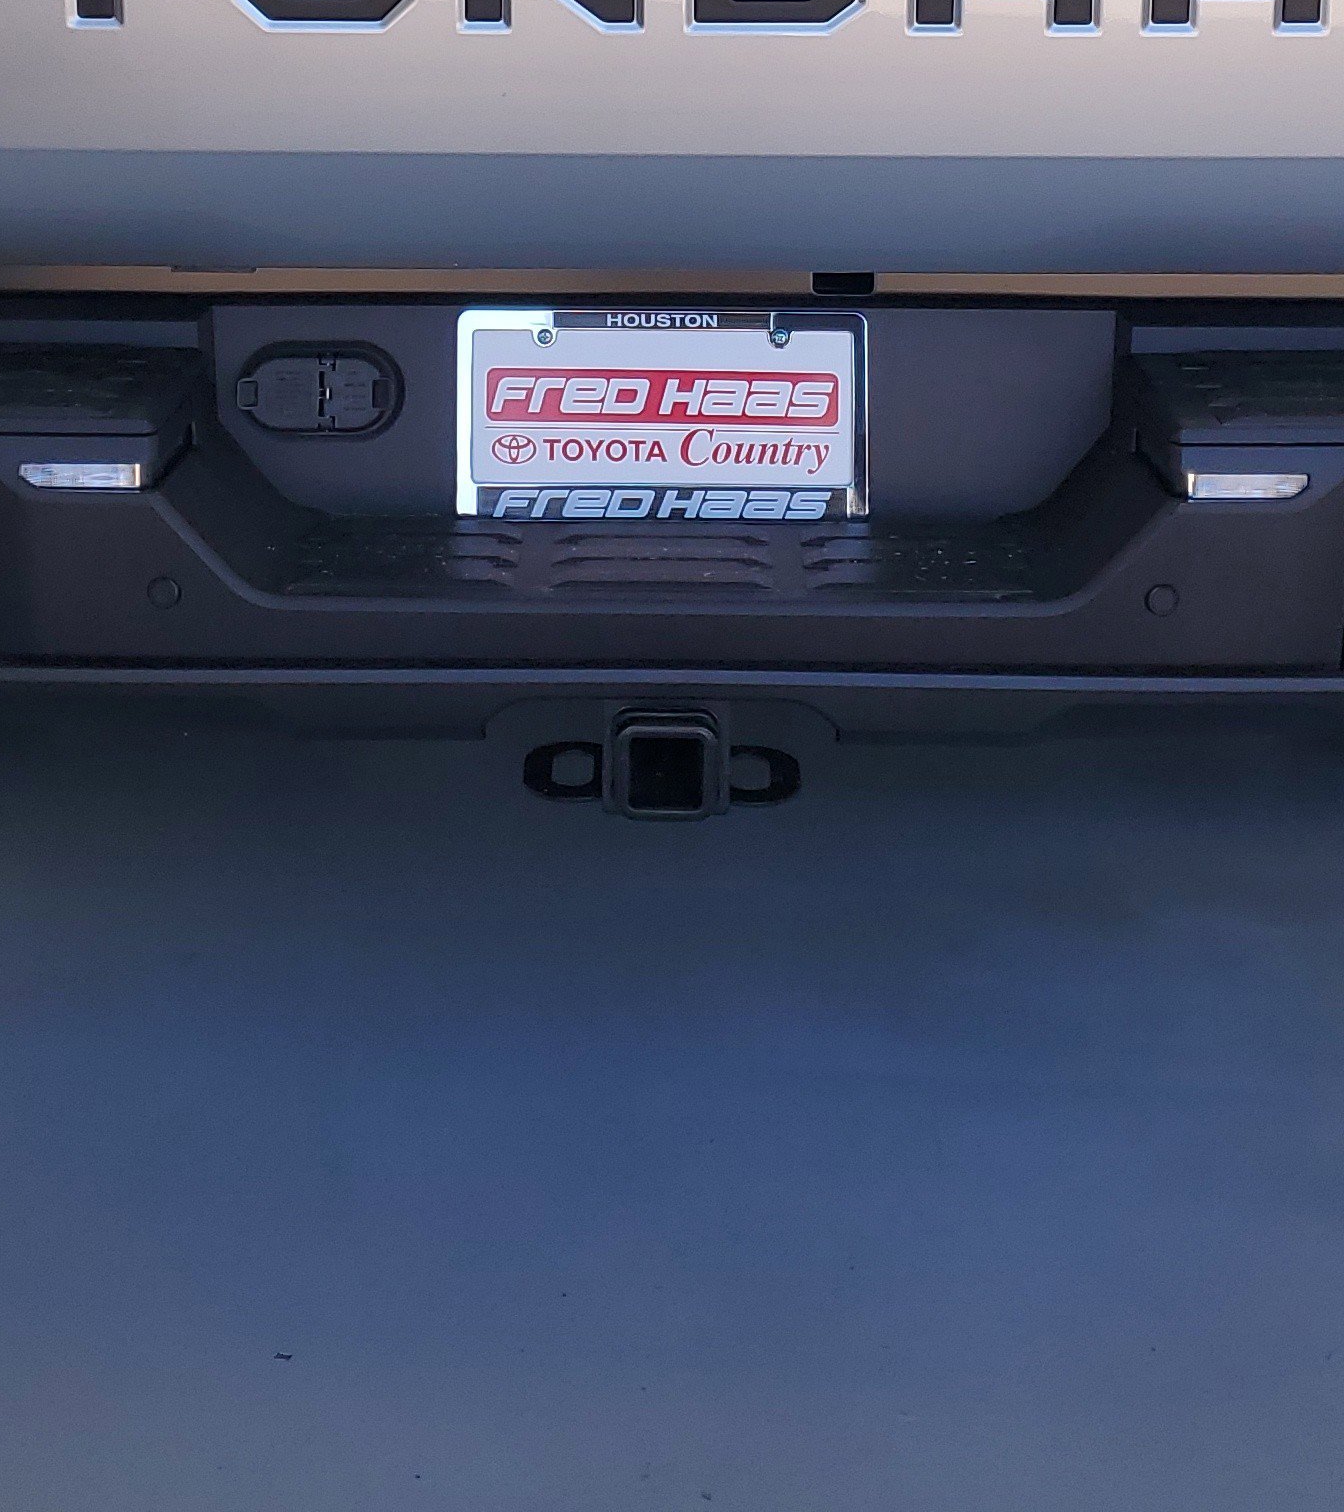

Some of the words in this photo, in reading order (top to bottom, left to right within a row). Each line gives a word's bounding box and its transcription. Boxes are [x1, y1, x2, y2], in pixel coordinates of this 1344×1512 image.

[605, 313, 718, 328] HOUSTON
[542, 438, 668, 463] TOYOTA
[679, 428, 832, 475] Country
